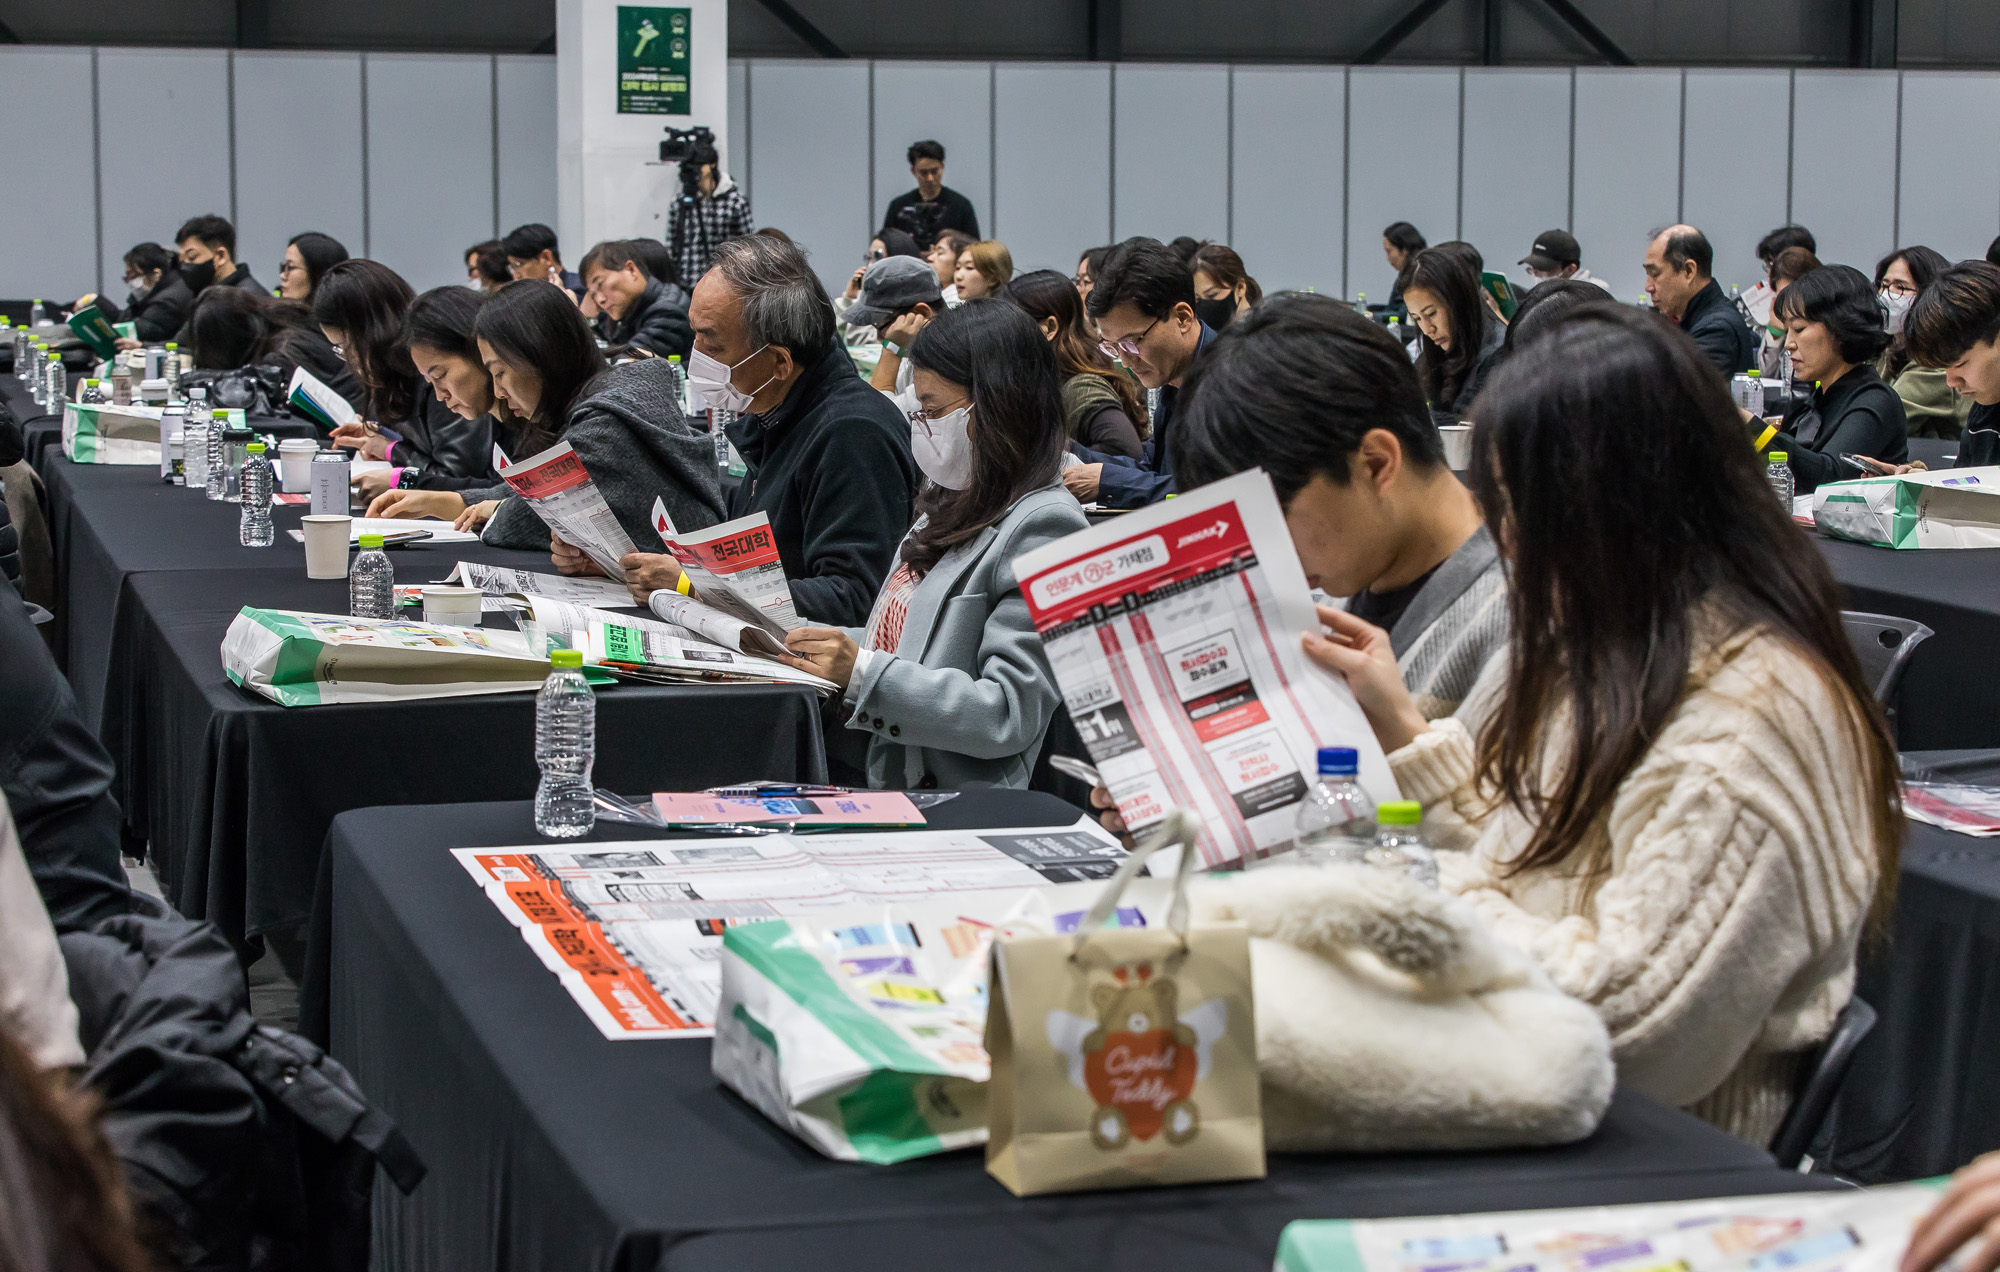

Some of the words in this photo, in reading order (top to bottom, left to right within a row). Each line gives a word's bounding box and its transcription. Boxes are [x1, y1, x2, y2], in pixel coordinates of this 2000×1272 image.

[539, 455, 579, 483] 전국대학
[711, 530, 770, 562] 전국대학
[1116, 545, 1155, 570] 가채점
[1104, 1044, 1177, 1082] Cupid
[1109, 1077, 1178, 1110] Teddy
